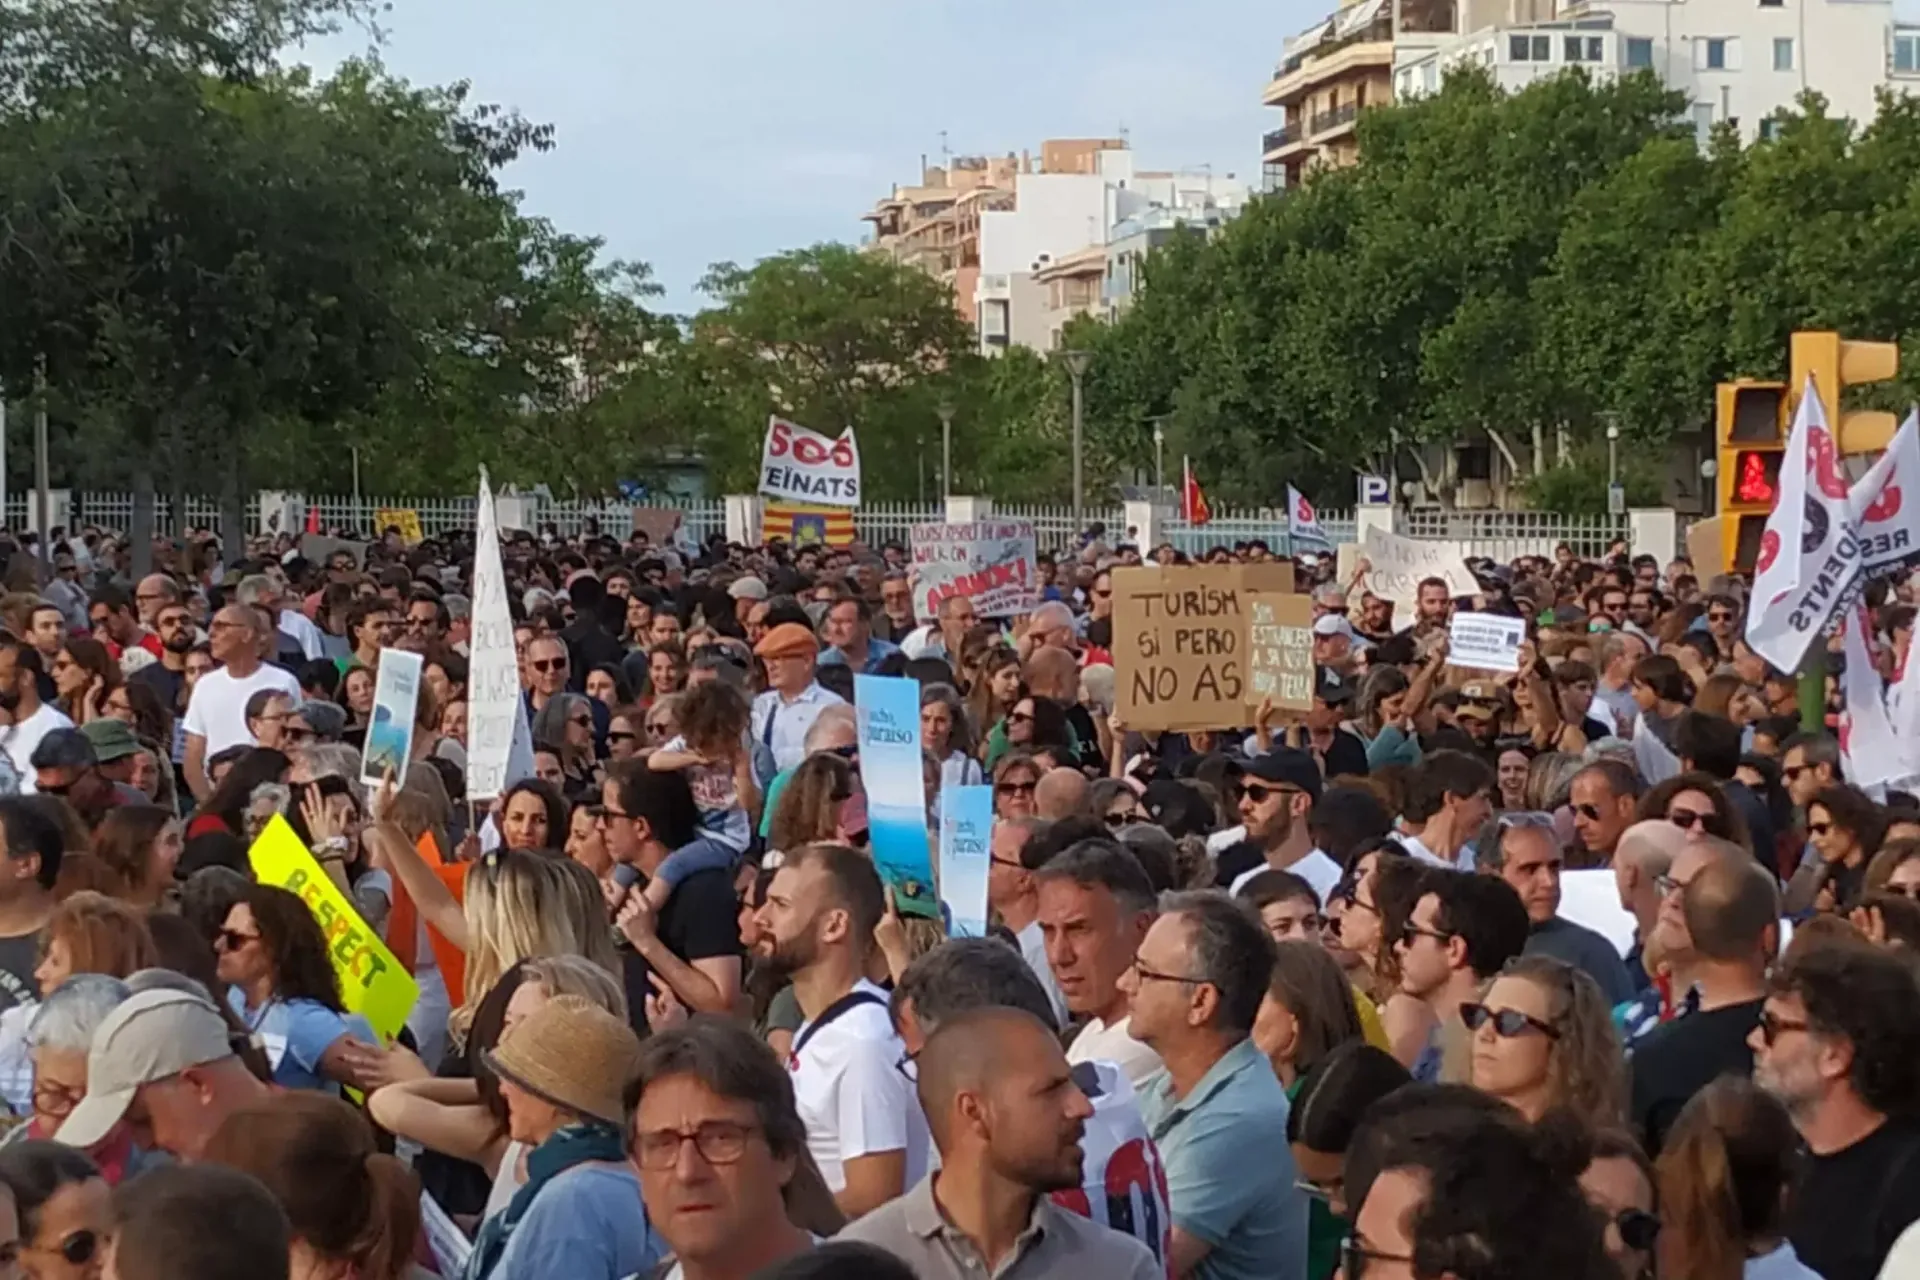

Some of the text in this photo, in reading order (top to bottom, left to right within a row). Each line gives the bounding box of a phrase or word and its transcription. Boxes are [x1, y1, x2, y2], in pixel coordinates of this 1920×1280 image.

[764, 465, 857, 498] EÏNATS
[1362, 476, 1388, 505] P
[1131, 585, 1243, 618] TURiSM
[1175, 628, 1236, 655] PERO
[1132, 664, 1178, 706] NO
